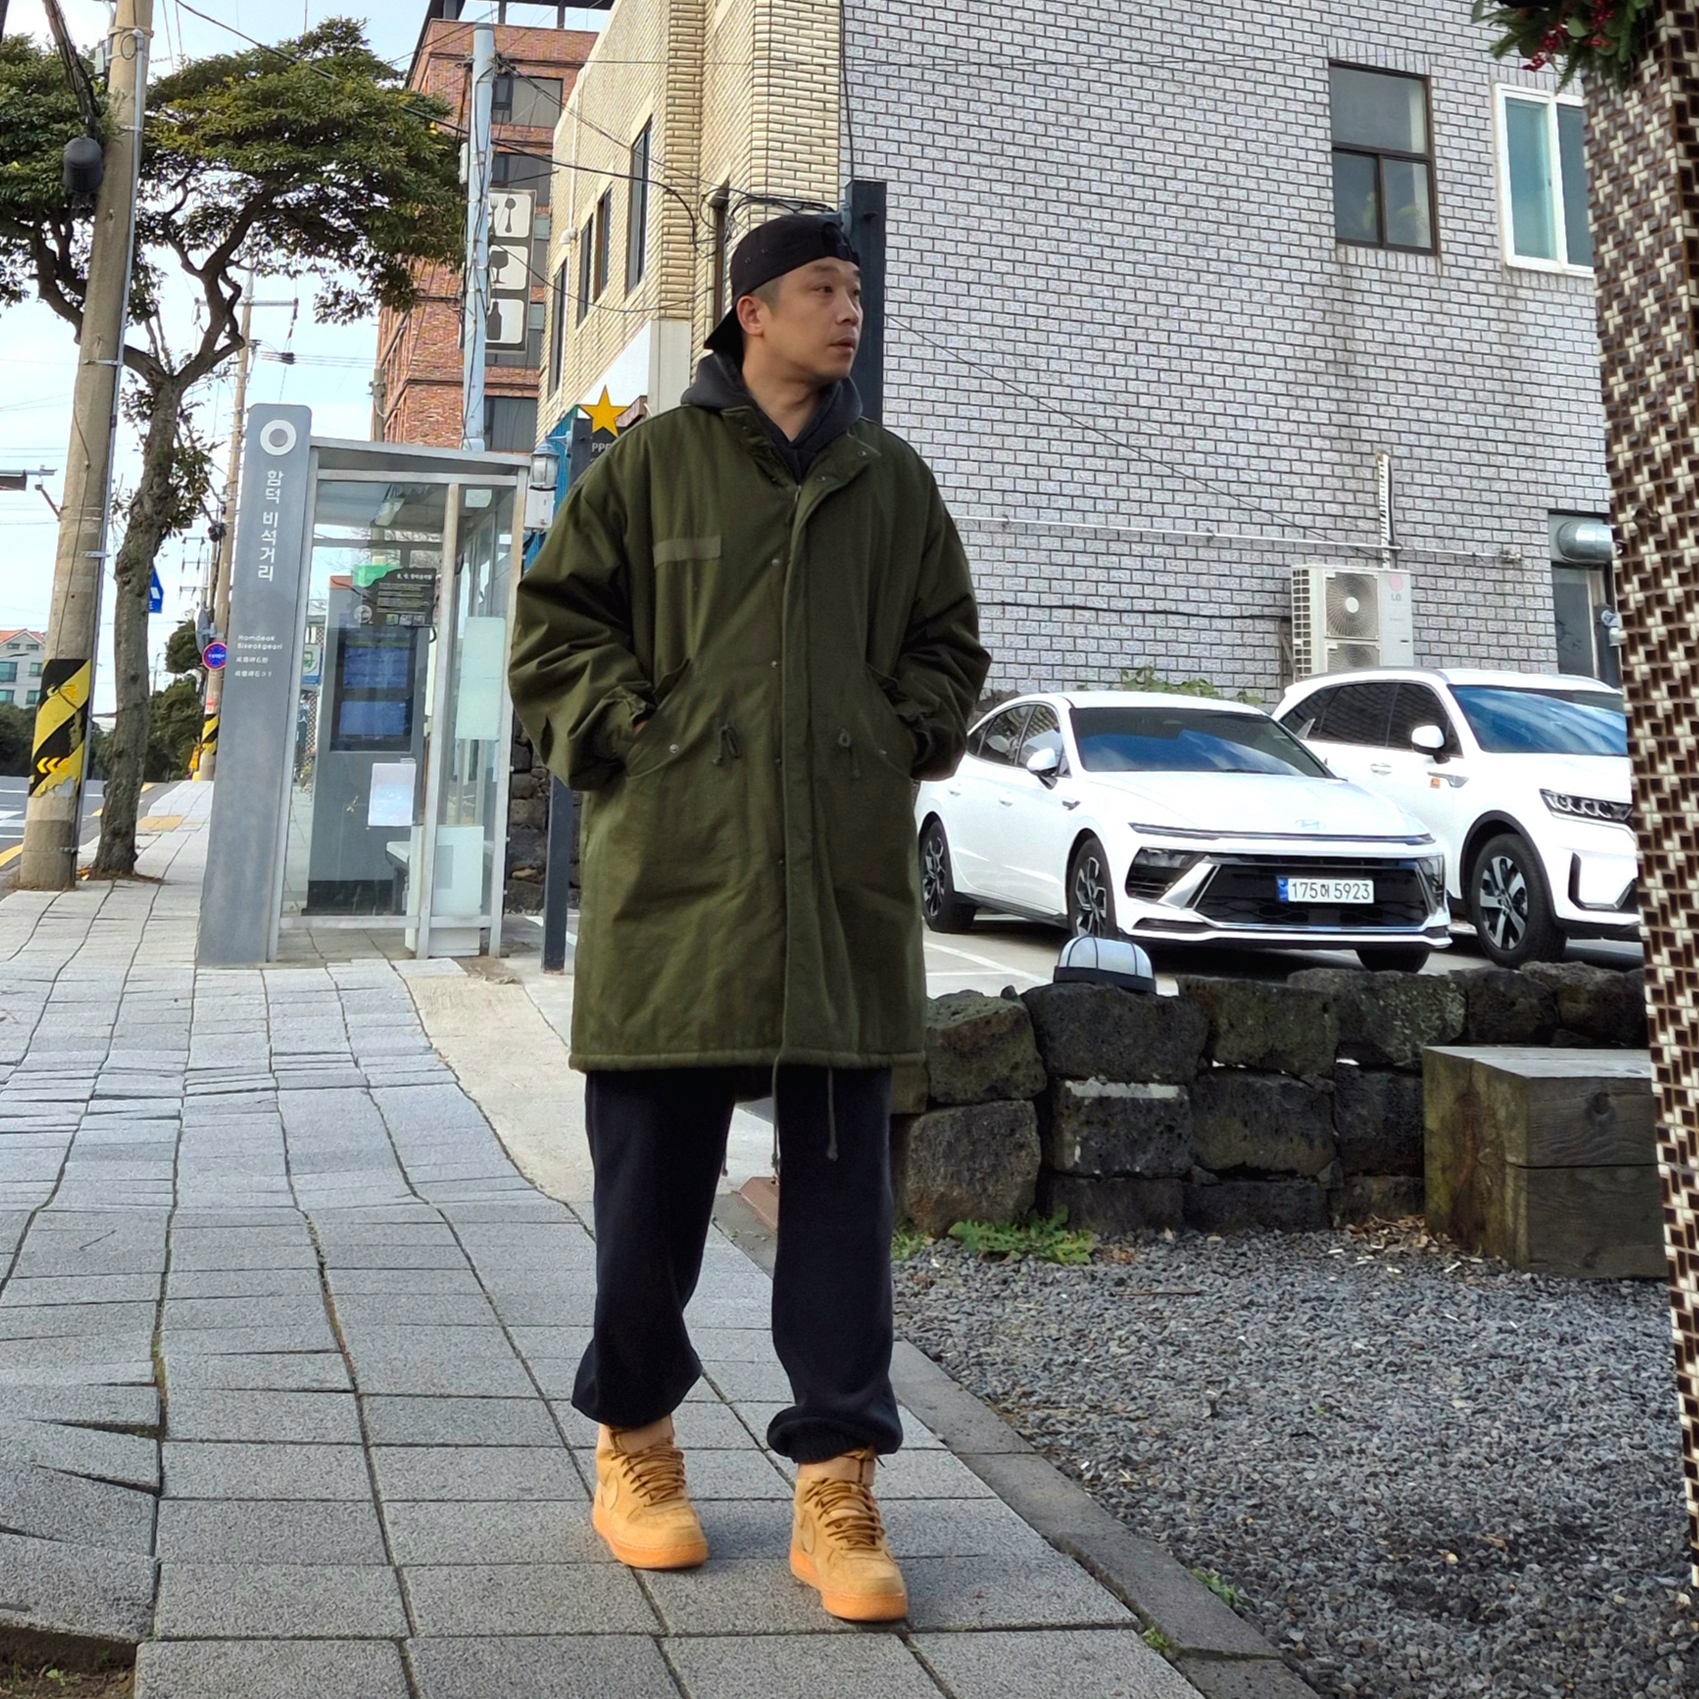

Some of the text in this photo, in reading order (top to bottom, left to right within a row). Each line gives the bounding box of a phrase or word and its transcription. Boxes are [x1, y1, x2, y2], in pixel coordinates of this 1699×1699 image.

[258, 470, 284, 582] 함덕 비석거리
[1334, 883, 1370, 900] 5923
